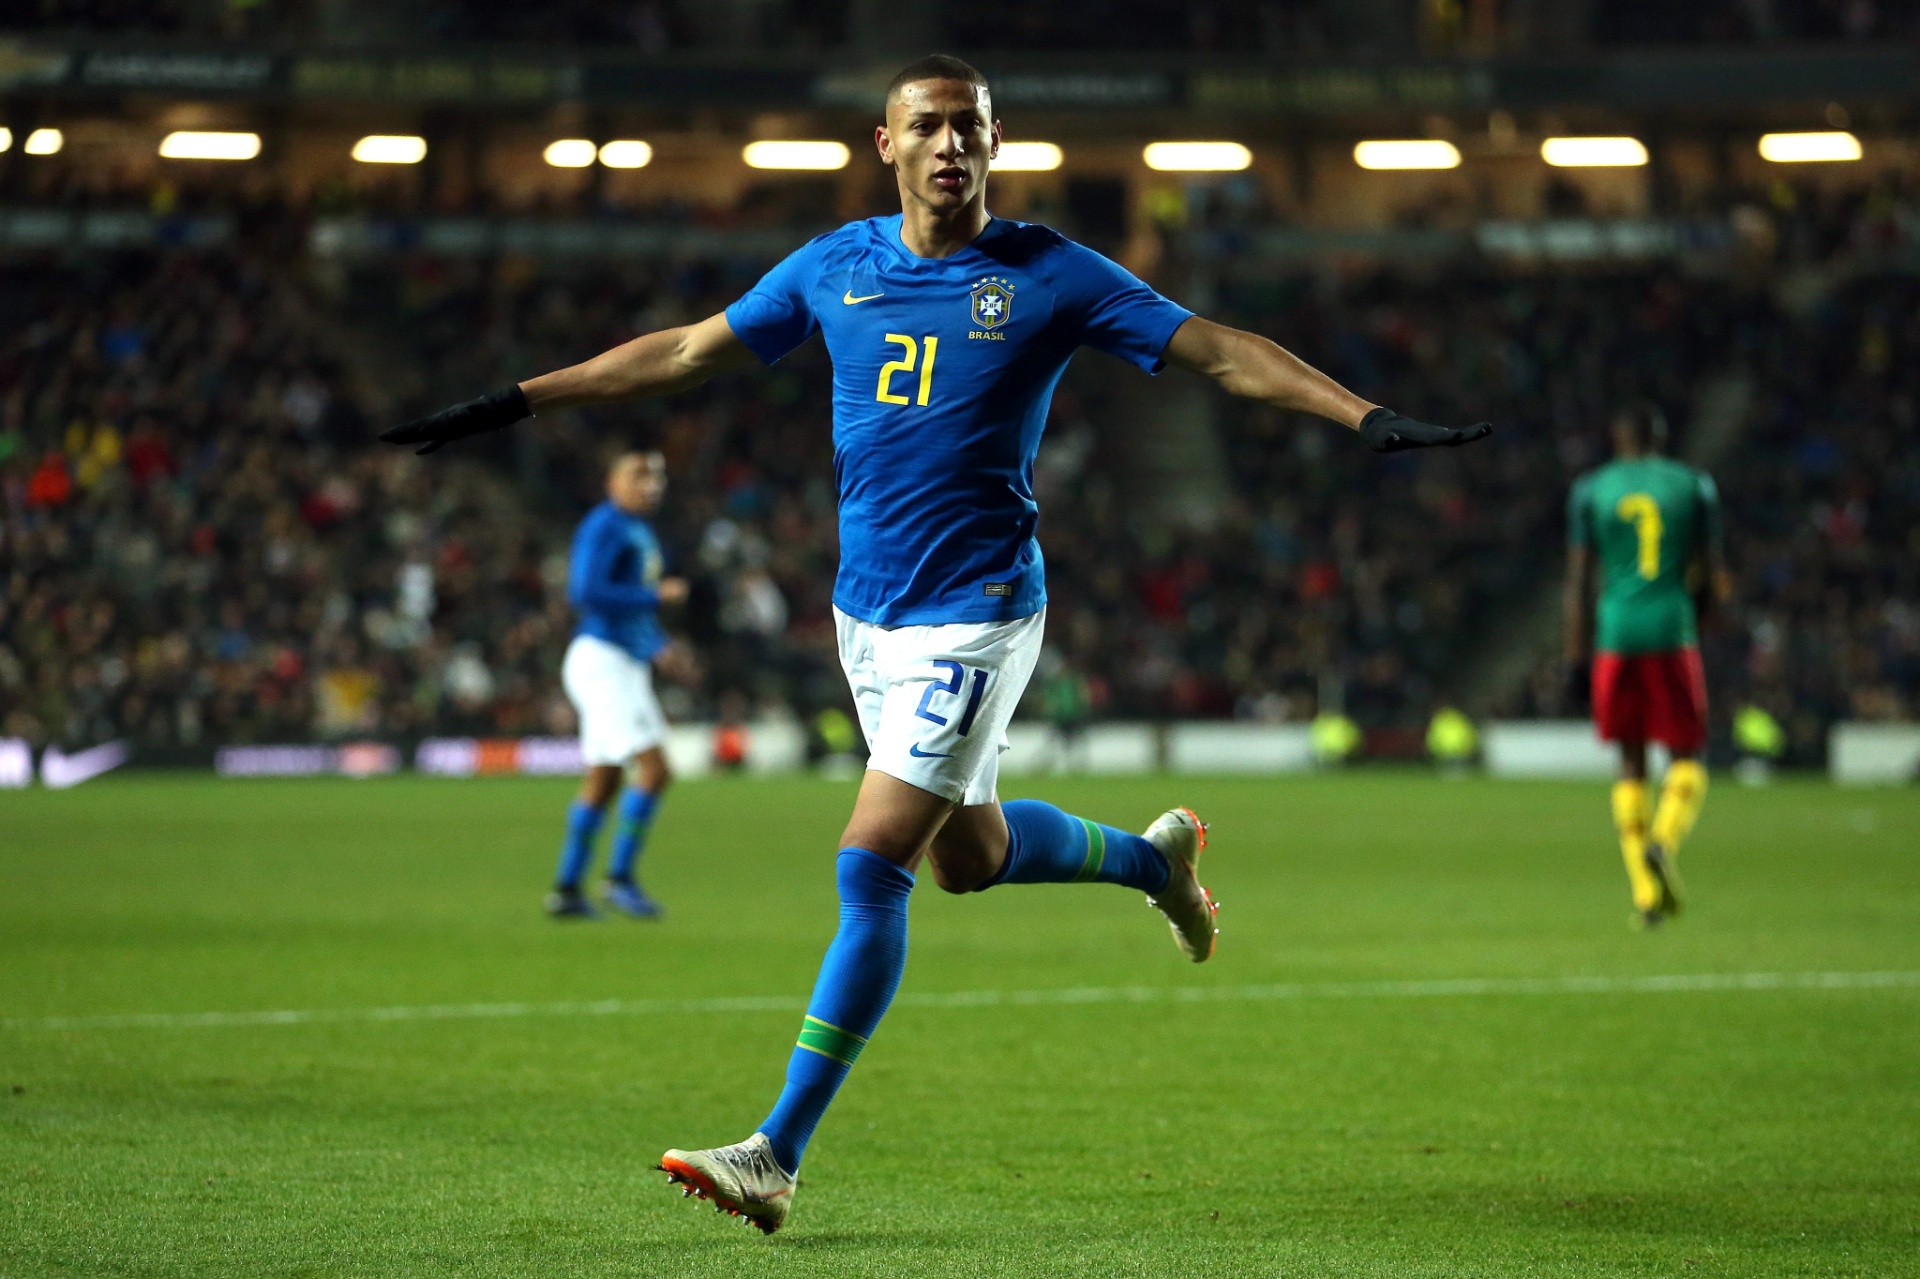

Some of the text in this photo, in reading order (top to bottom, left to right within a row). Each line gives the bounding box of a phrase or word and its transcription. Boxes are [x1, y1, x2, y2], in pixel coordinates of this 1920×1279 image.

[876, 333, 938, 406] 21
[968, 331, 1006, 341] BRASIL
[914, 659, 989, 737] 21
